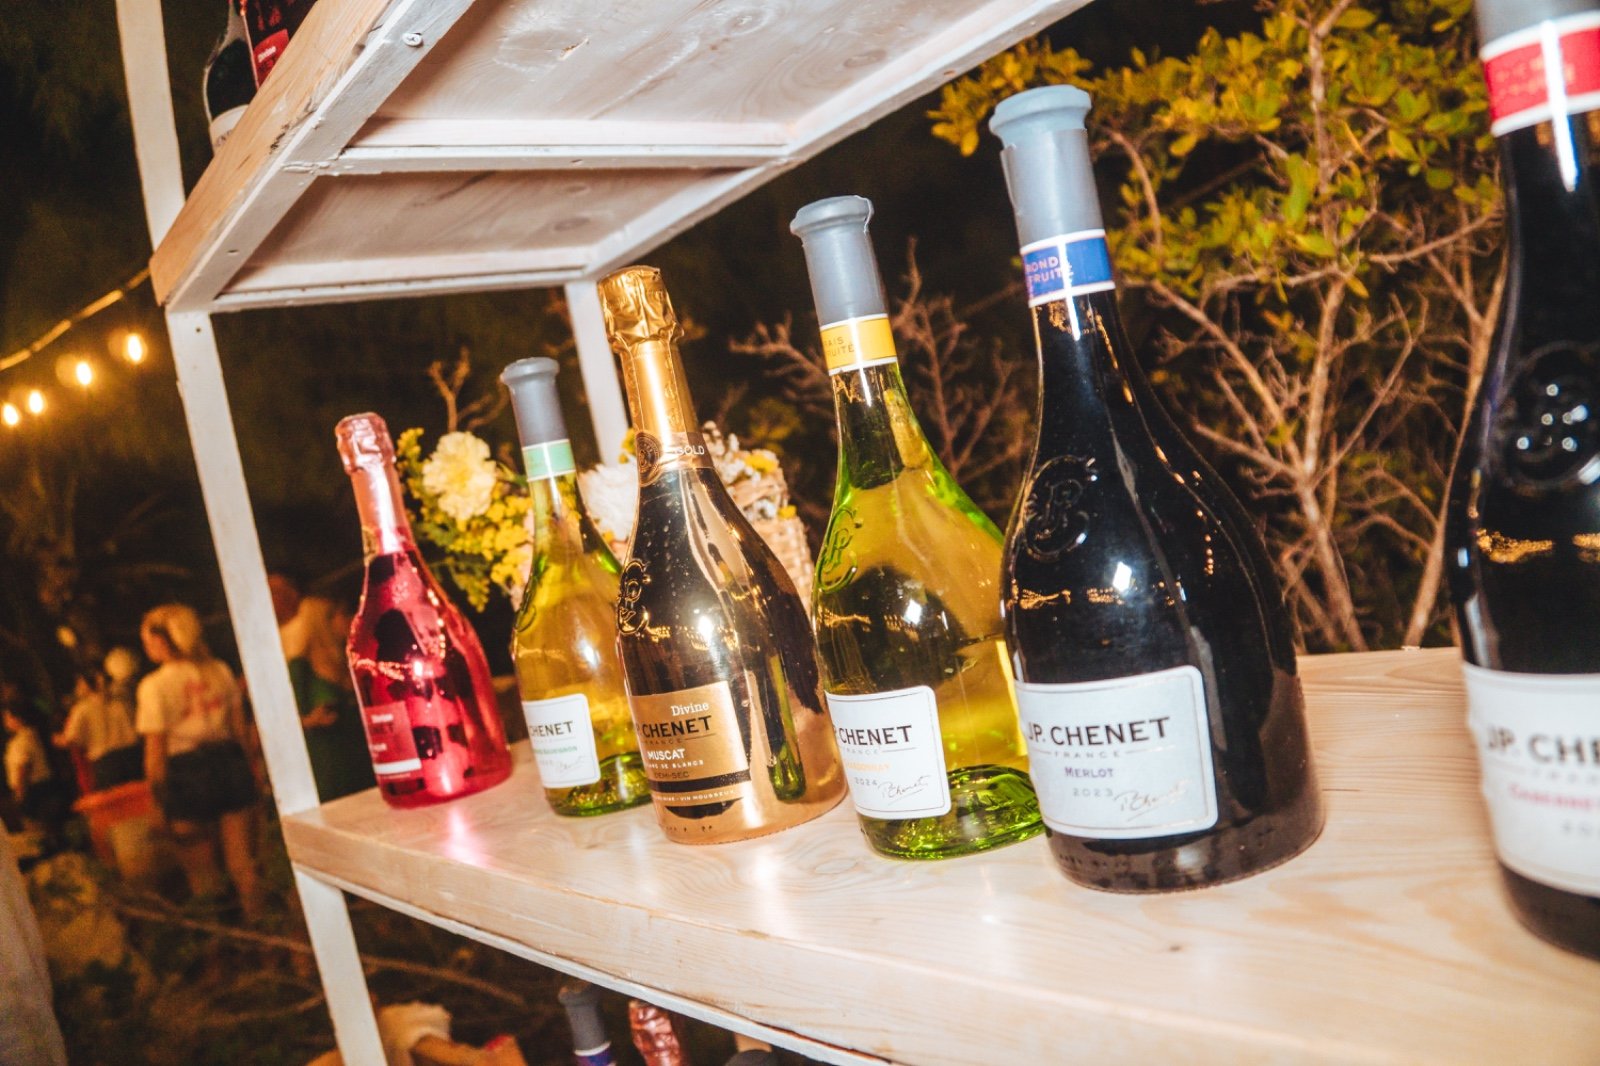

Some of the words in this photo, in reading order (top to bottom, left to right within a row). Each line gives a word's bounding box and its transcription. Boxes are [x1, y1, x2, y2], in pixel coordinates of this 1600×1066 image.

[671, 703, 710, 716] Divine
[642, 715, 712, 738] CHENET
[1028, 722, 1047, 743] JP.
[1050, 717, 1170, 746] CHENET
[838, 725, 912, 746] CHENET
[647, 748, 686, 760] MUSCAT
[1054, 751, 1121, 760] FRANCE
[1064, 766, 1114, 778] MERLOT
[1073, 787, 1113, 797] 2023
